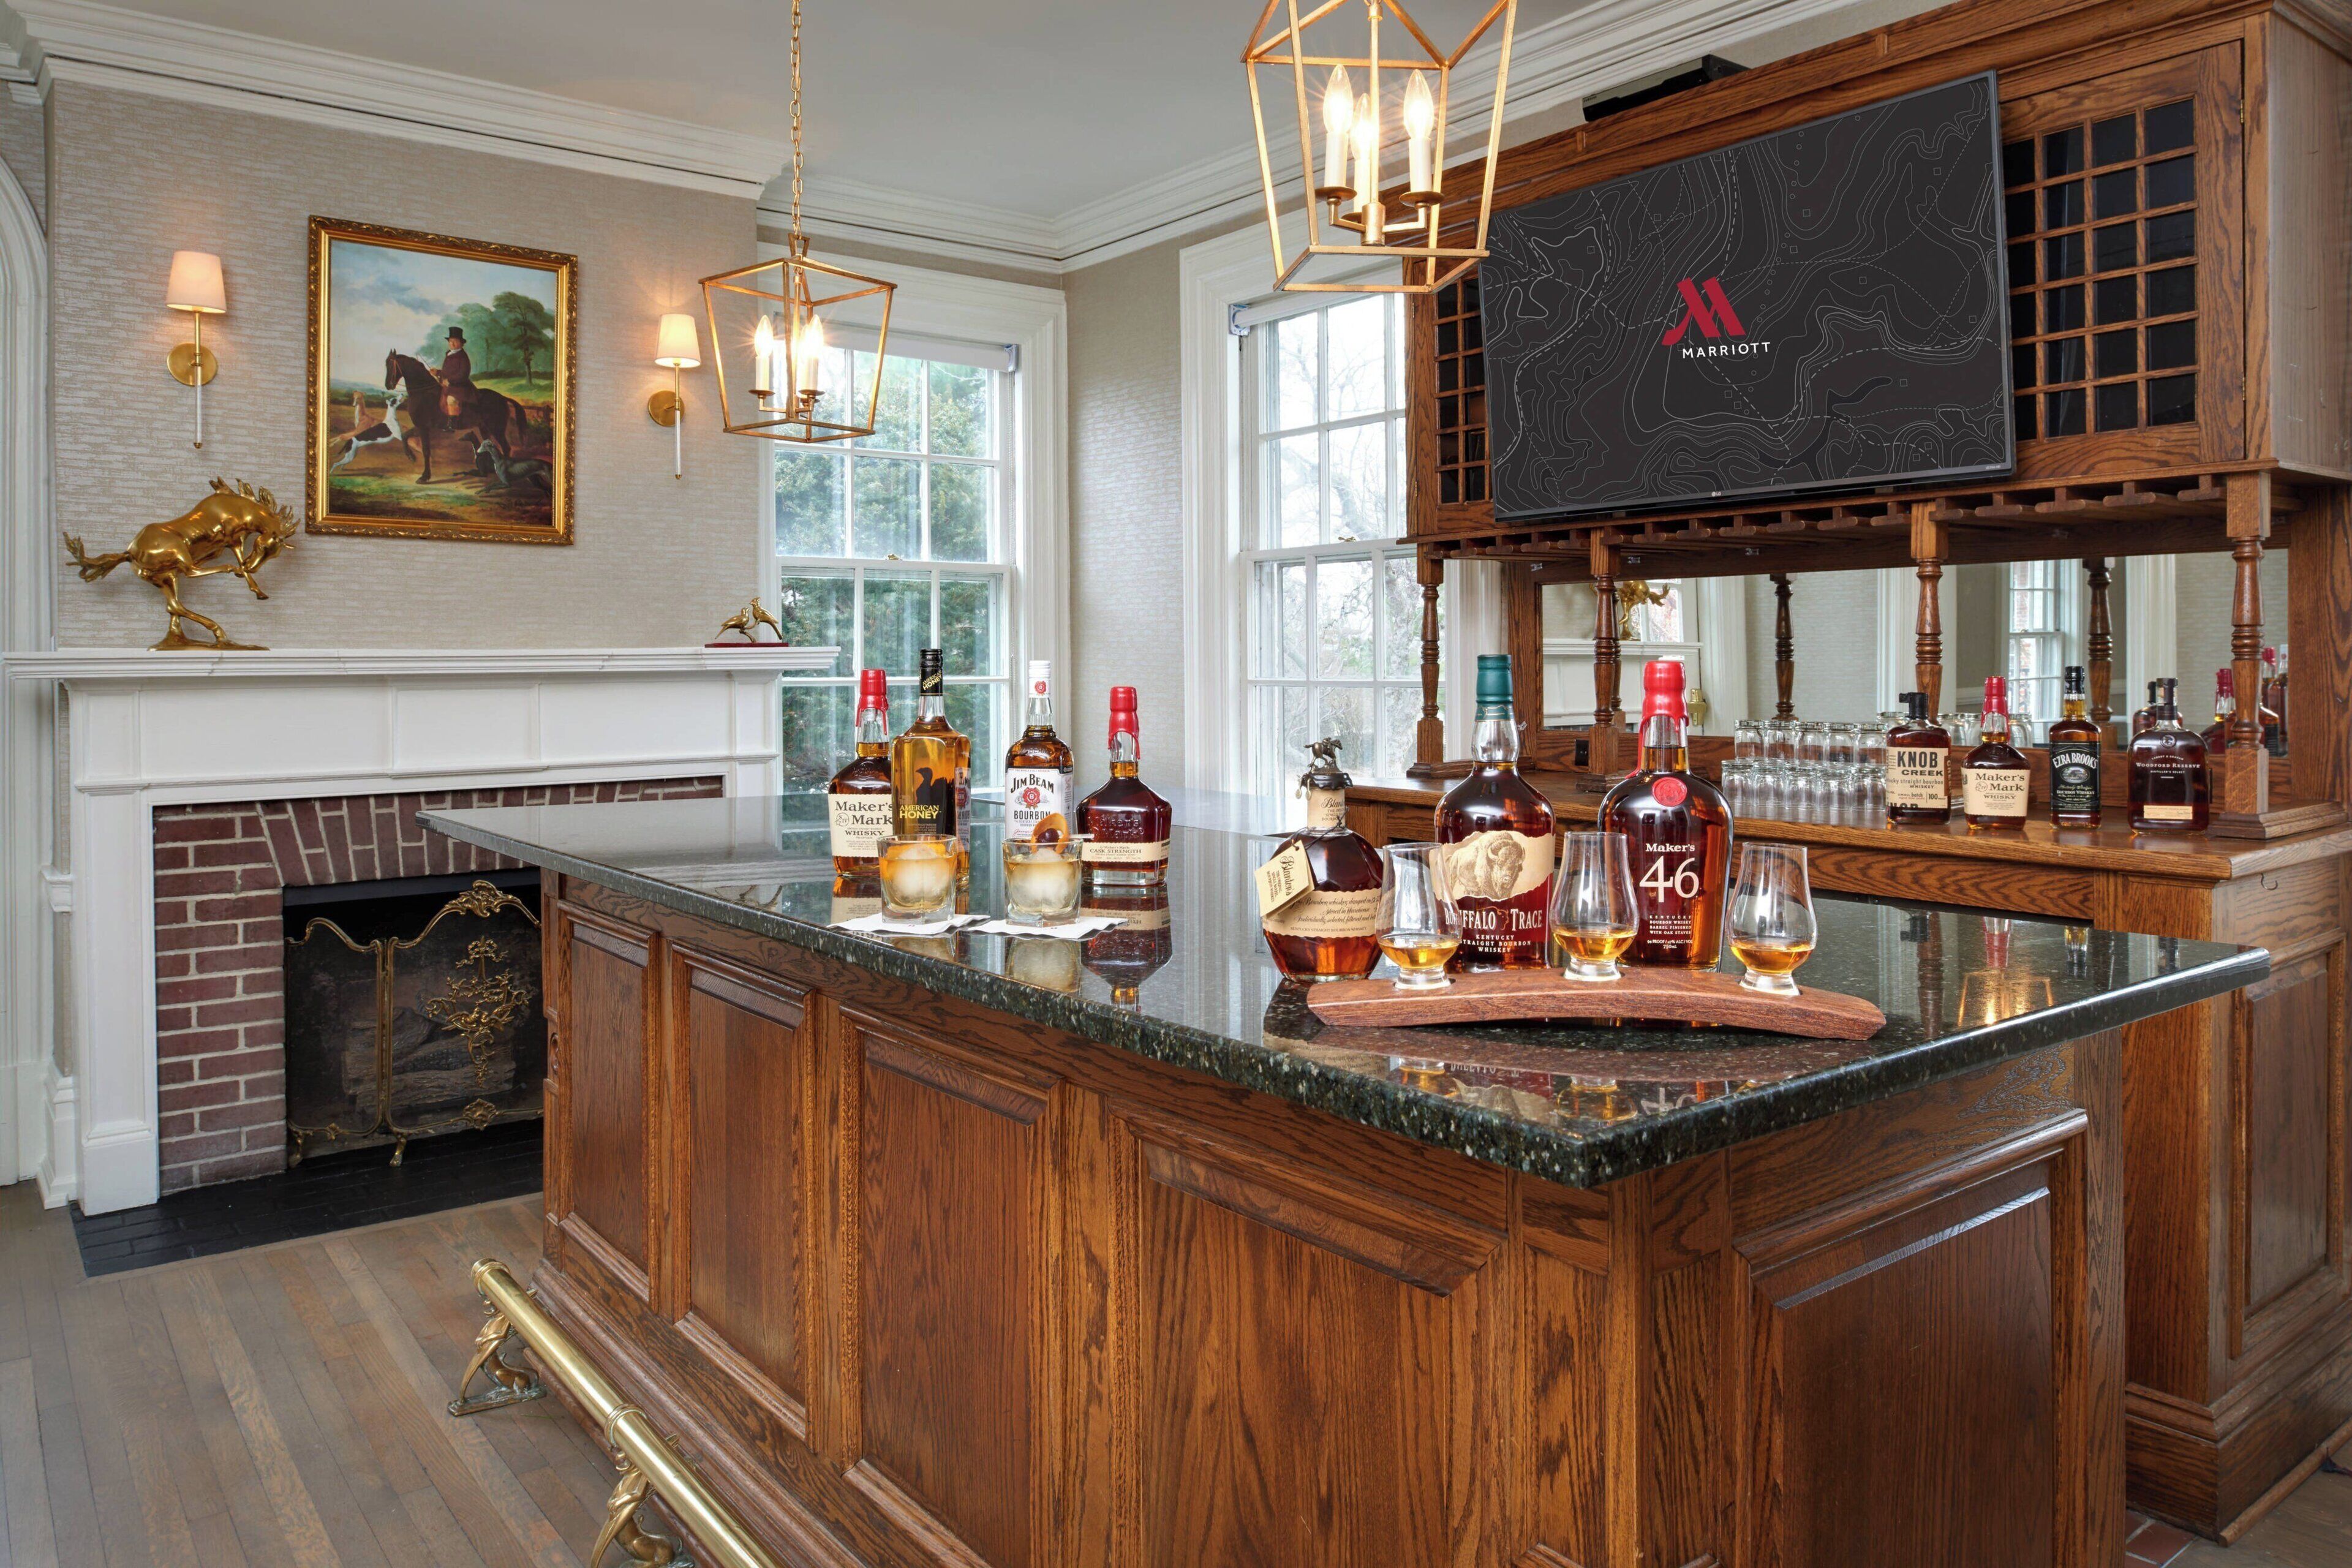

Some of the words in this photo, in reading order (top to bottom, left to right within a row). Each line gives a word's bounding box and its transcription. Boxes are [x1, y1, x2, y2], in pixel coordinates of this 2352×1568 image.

[1683, 342, 1770, 359] MARRIOTT
[923, 674, 942, 690] HONEY
[1898, 751, 1938, 768] KNOB
[2052, 753, 2070, 768] EZRA
[2071, 753, 2098, 769] BROOKS
[1011, 777, 1027, 793] JIM
[1029, 774, 1054, 794] BEAM
[835, 801, 893, 812] Maker's
[851, 815, 893, 825] Mark
[1014, 810, 1050, 820] BOURBON
[1646, 843, 1695, 852] Maker's
[1280, 856, 1294, 895] Blanton's
[1639, 856, 1699, 903] 46
[1510, 909, 1542, 931] TRACE
